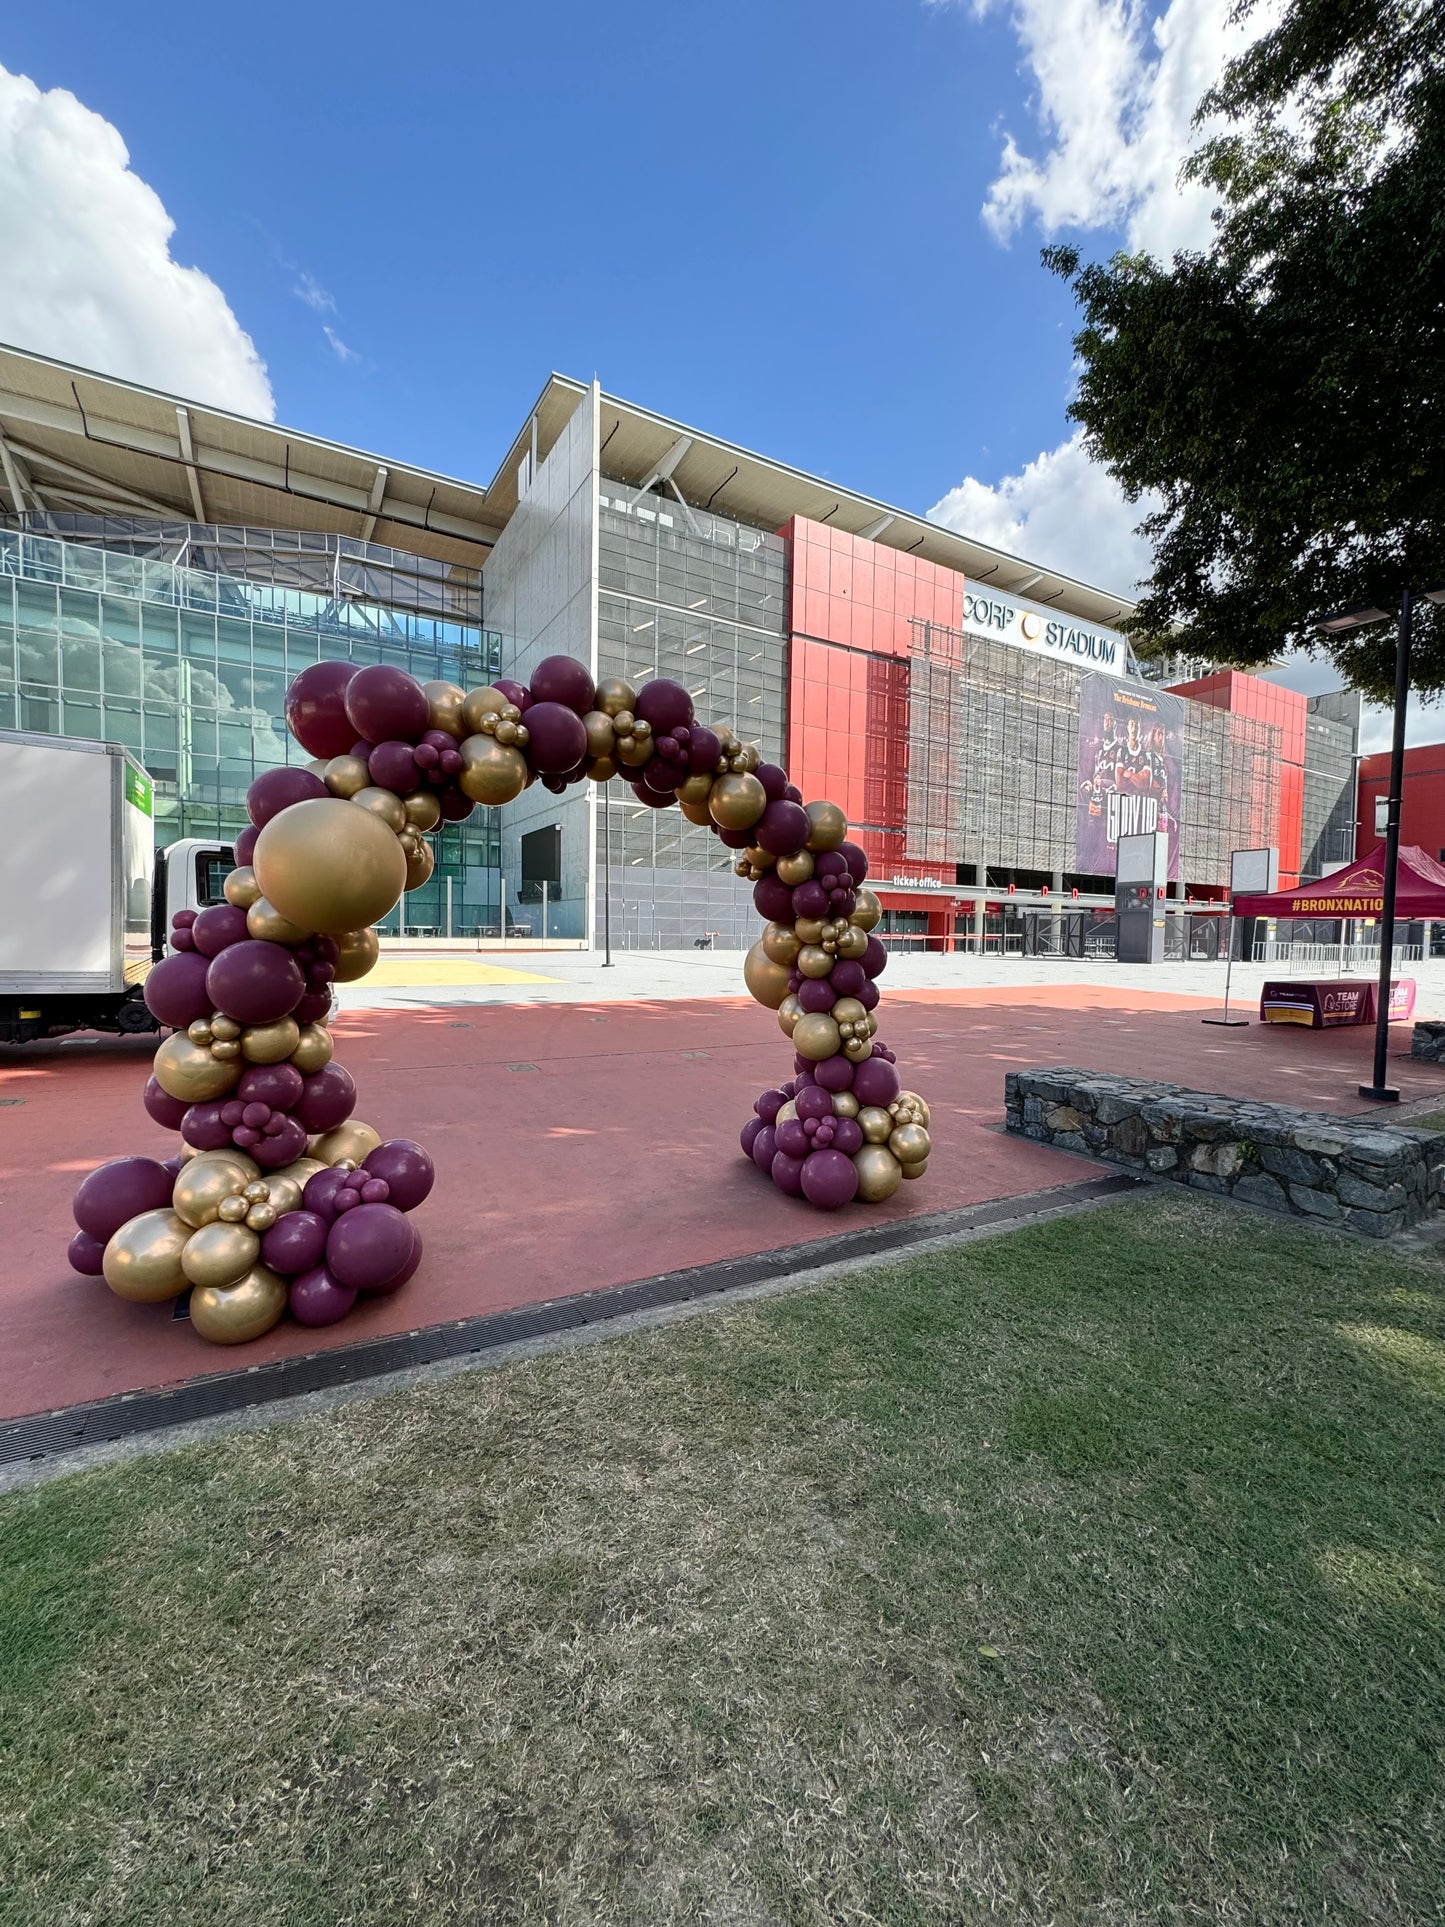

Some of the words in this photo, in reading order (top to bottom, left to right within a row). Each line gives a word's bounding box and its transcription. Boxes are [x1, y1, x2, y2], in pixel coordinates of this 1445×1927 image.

[963, 594, 1015, 631] CORP
[1045, 621, 1115, 665] STADIUM
[893, 875, 918, 888] ticket
[919, 876, 942, 889] office
[1008, 883, 1016, 896] D
[1042, 885, 1049, 898] D
[1072, 887, 1079, 900] D
[1157, 887, 1165, 899] D
[1337, 991, 1359, 1001] TEAM
[1334, 1000, 1358, 1011] STORE
